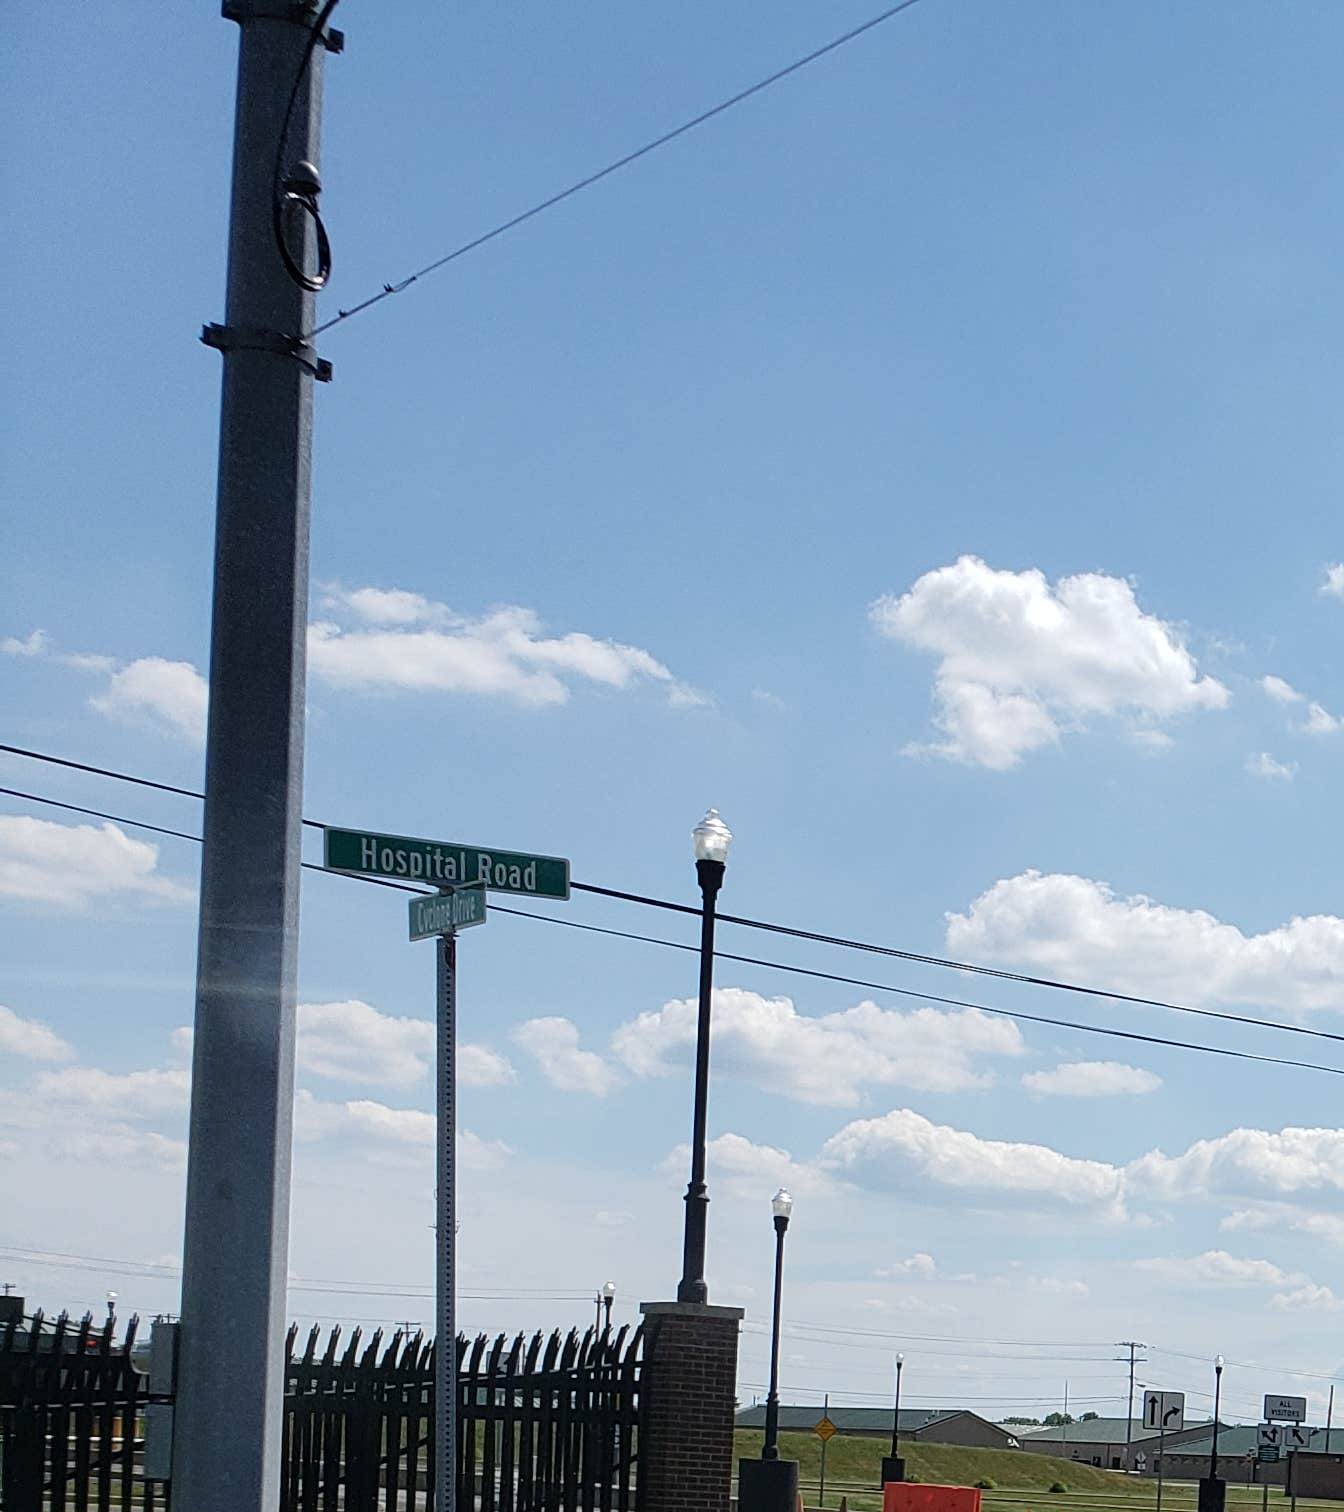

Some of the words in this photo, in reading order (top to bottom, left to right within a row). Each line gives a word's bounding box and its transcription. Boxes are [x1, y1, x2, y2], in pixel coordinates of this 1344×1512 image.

[361, 837, 466, 881] Hospital
[477, 853, 537, 891] Road
[453, 893, 476, 924] Drive
[1280, 1400, 1292, 1408] ALL
